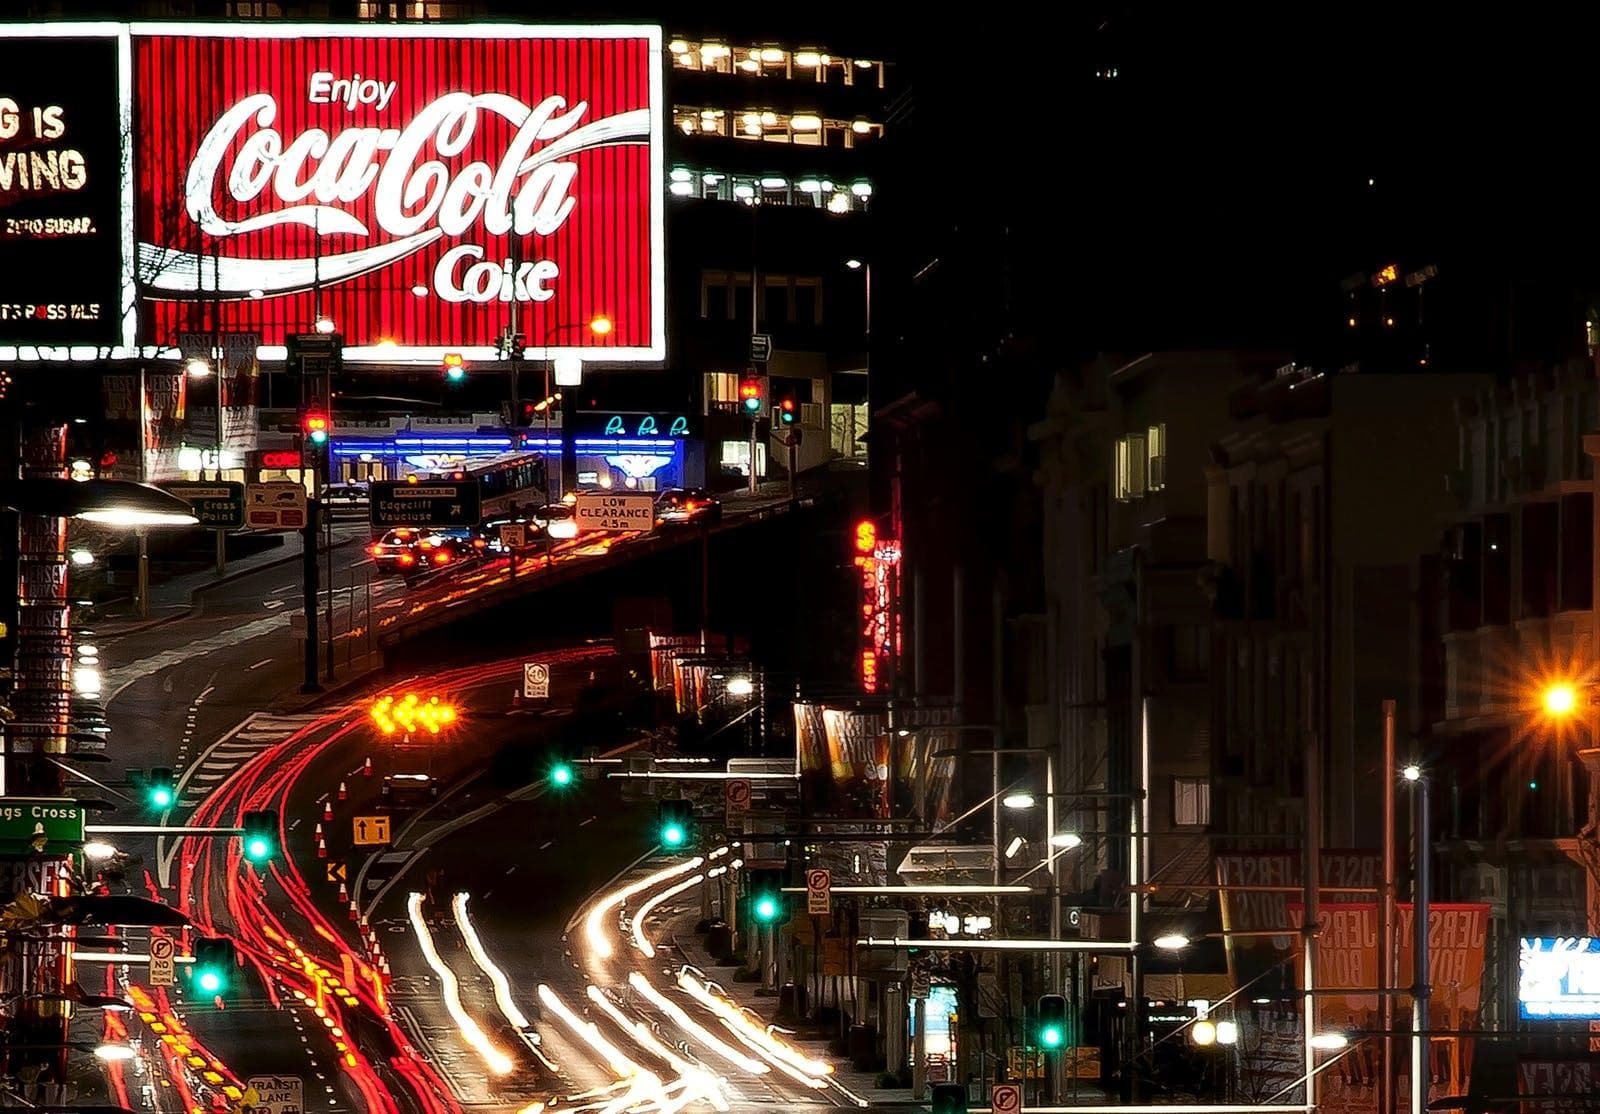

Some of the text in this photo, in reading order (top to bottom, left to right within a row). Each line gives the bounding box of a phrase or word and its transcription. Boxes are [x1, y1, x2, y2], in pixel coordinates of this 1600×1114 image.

[309, 71, 397, 111] Enjoy
[33, 105, 65, 139] IS
[185, 91, 588, 237] Coca-Cola
[433, 244, 559, 303] Coke
[203, 501, 236, 510] Cross
[602, 498, 626, 507] LOW
[202, 512, 234, 521] Point
[580, 508, 649, 518] CLEARANCE
[600, 519, 629, 529] 4.5m
[31, 806, 77, 818] Cross
[812, 892, 826, 900] NO
[155, 961, 169, 969] NO
[250, 1080, 300, 1091] TRANSIT
[259, 1093, 291, 1103] LANE
